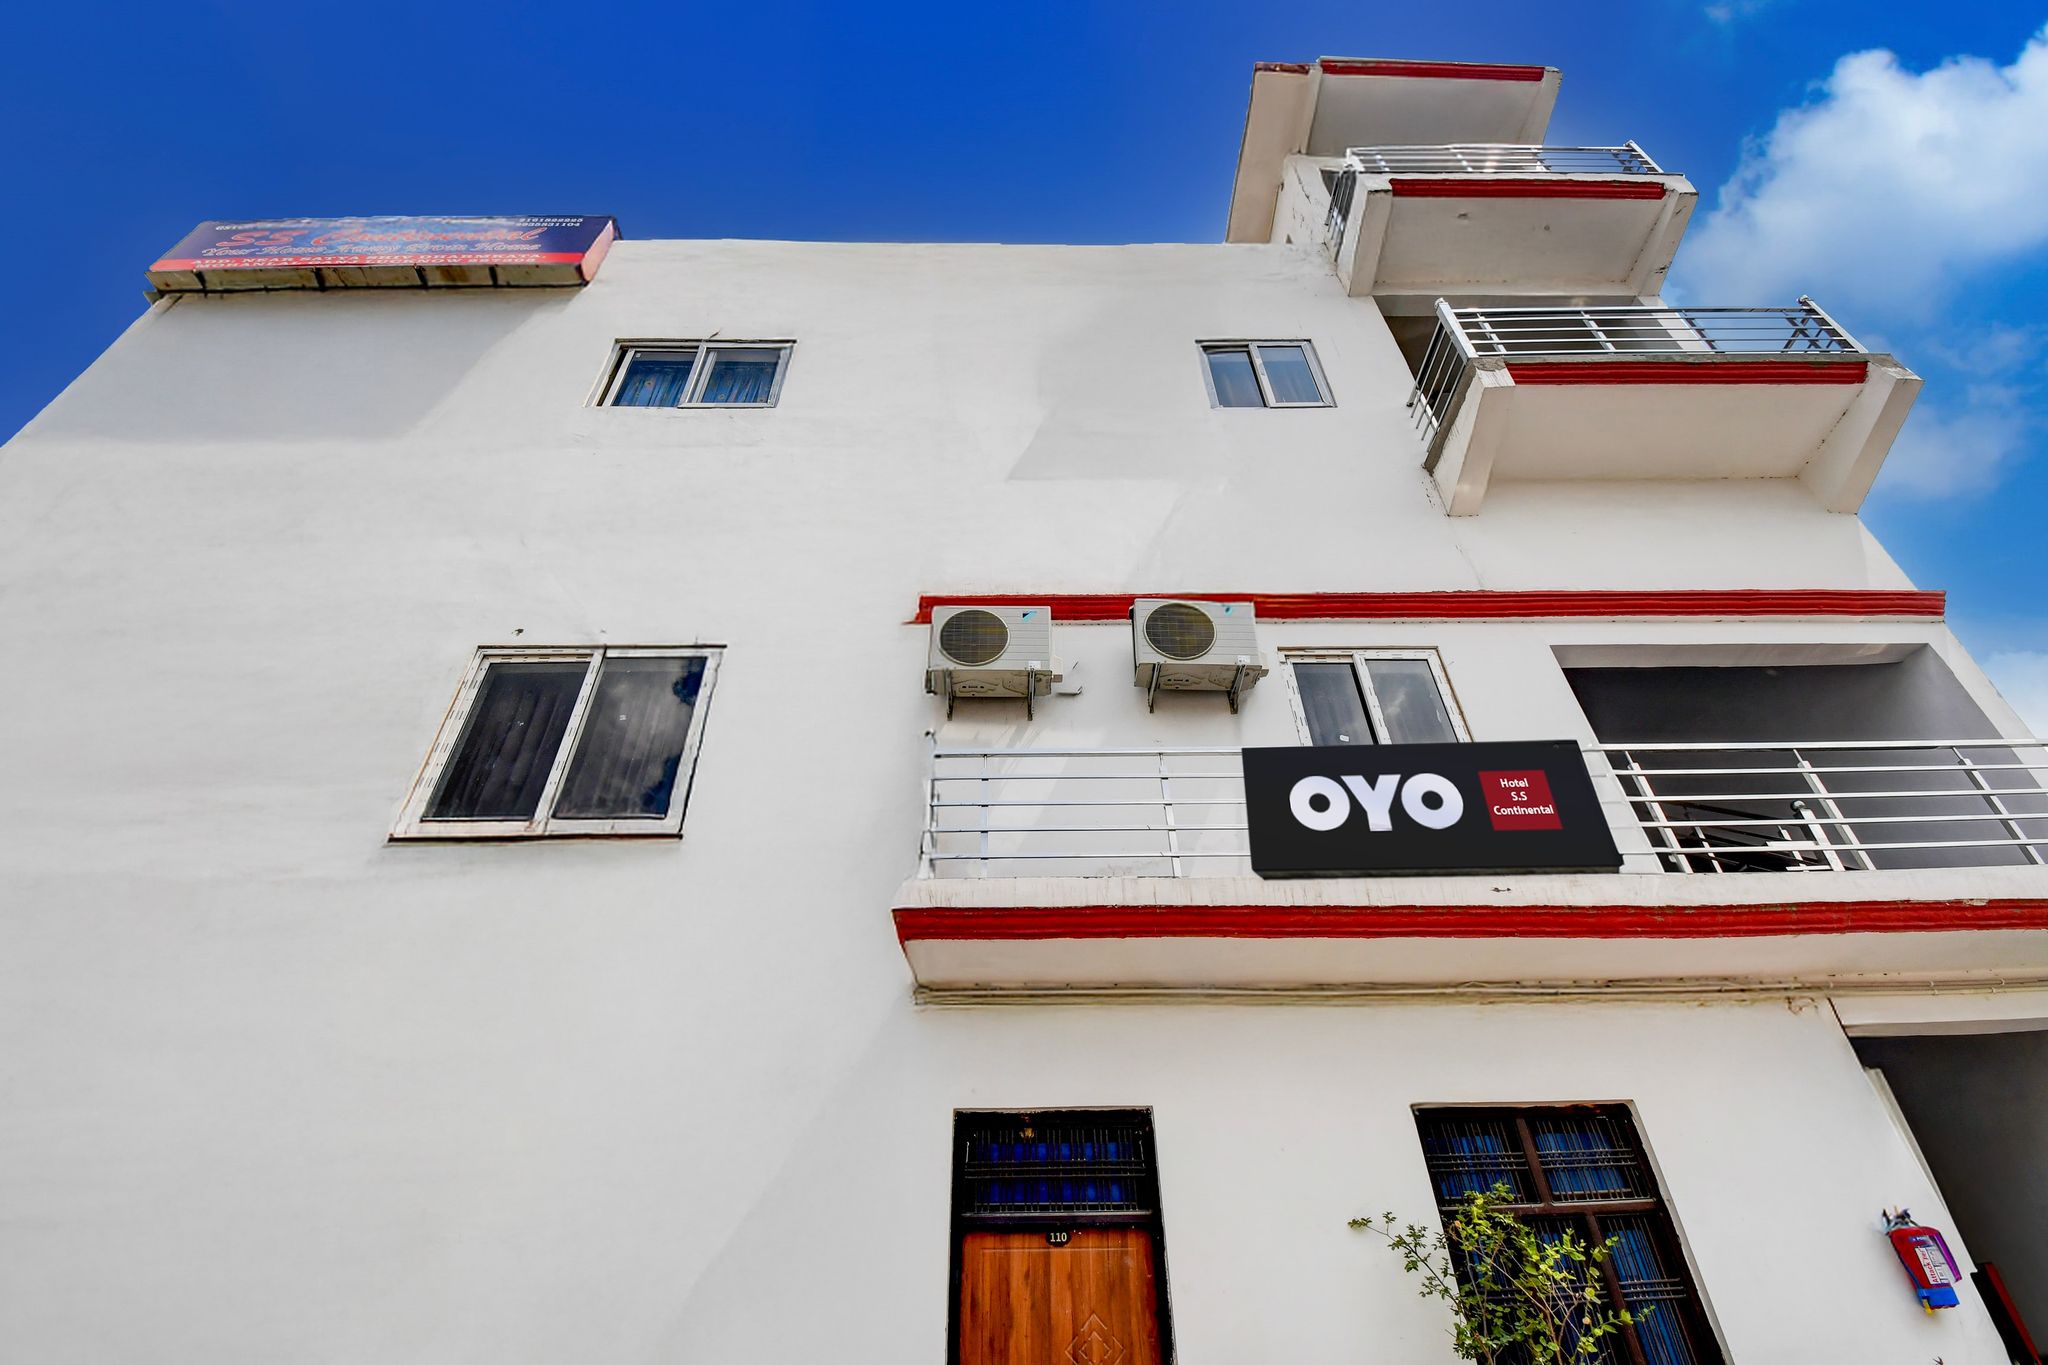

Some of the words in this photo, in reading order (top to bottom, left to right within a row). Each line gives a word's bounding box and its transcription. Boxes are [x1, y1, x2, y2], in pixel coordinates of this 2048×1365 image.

[215, 230, 308, 246] SS
[202, 248, 259, 257] Your
[256, 245, 327, 255] Home
[470, 242, 541, 251] Home
[1500, 778, 1529, 788] Hotel
[1289, 772, 1464, 832] OYO
[1511, 791, 1528, 801] S.S
[1493, 804, 1555, 815] Continental
[1050, 1232, 1068, 1243] 110
[1926, 1262, 1939, 1283] Attack
